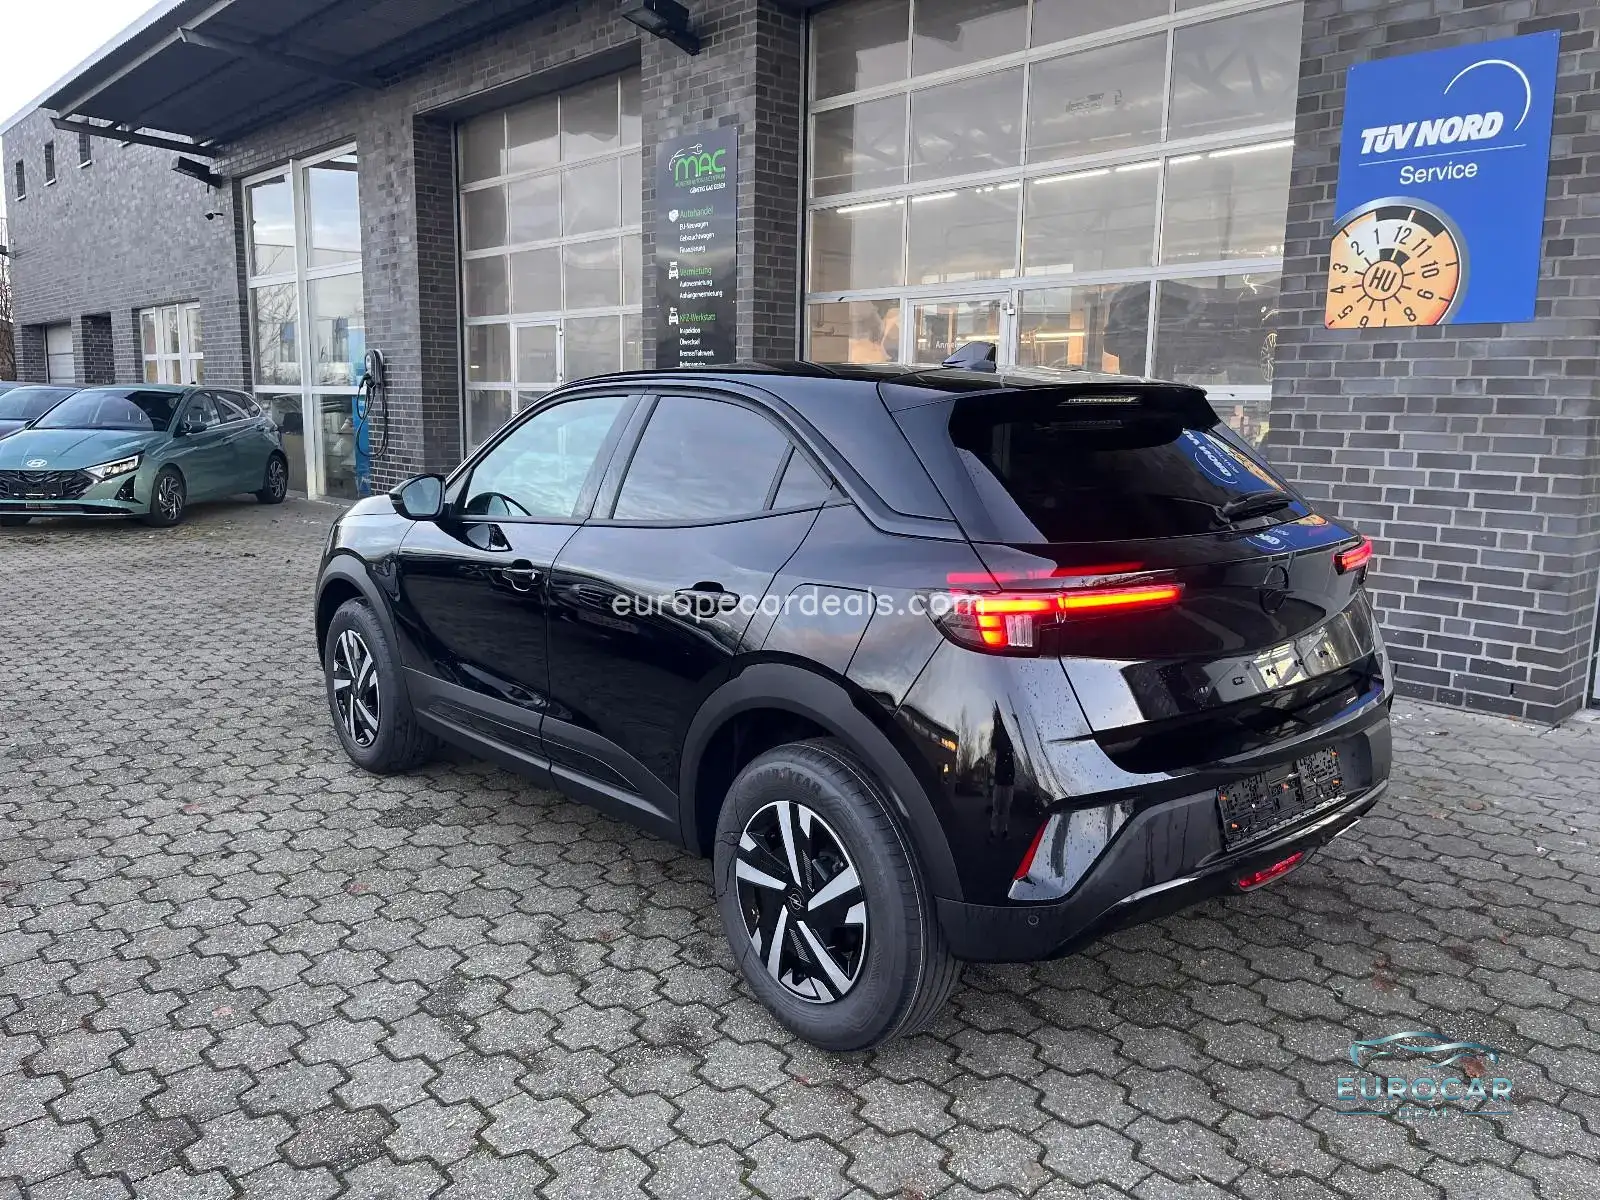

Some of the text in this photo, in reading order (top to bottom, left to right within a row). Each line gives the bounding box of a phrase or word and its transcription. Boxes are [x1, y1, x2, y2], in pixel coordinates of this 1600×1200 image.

[1360, 111, 1504, 155] TÜV NORD
[675, 148, 726, 182] MAC
[1399, 161, 1478, 185] Service
[680, 205, 714, 218] Autohandel
[1393, 225, 1412, 246] 12
[1350, 240, 1365, 257] 2
[1411, 237, 1432, 259] 11
[680, 267, 712, 276] Vermietung
[1332, 262, 1349, 274] 3
[1420, 260, 1440, 280] 10
[1368, 265, 1397, 293] HU
[1403, 306, 1416, 322] 8
